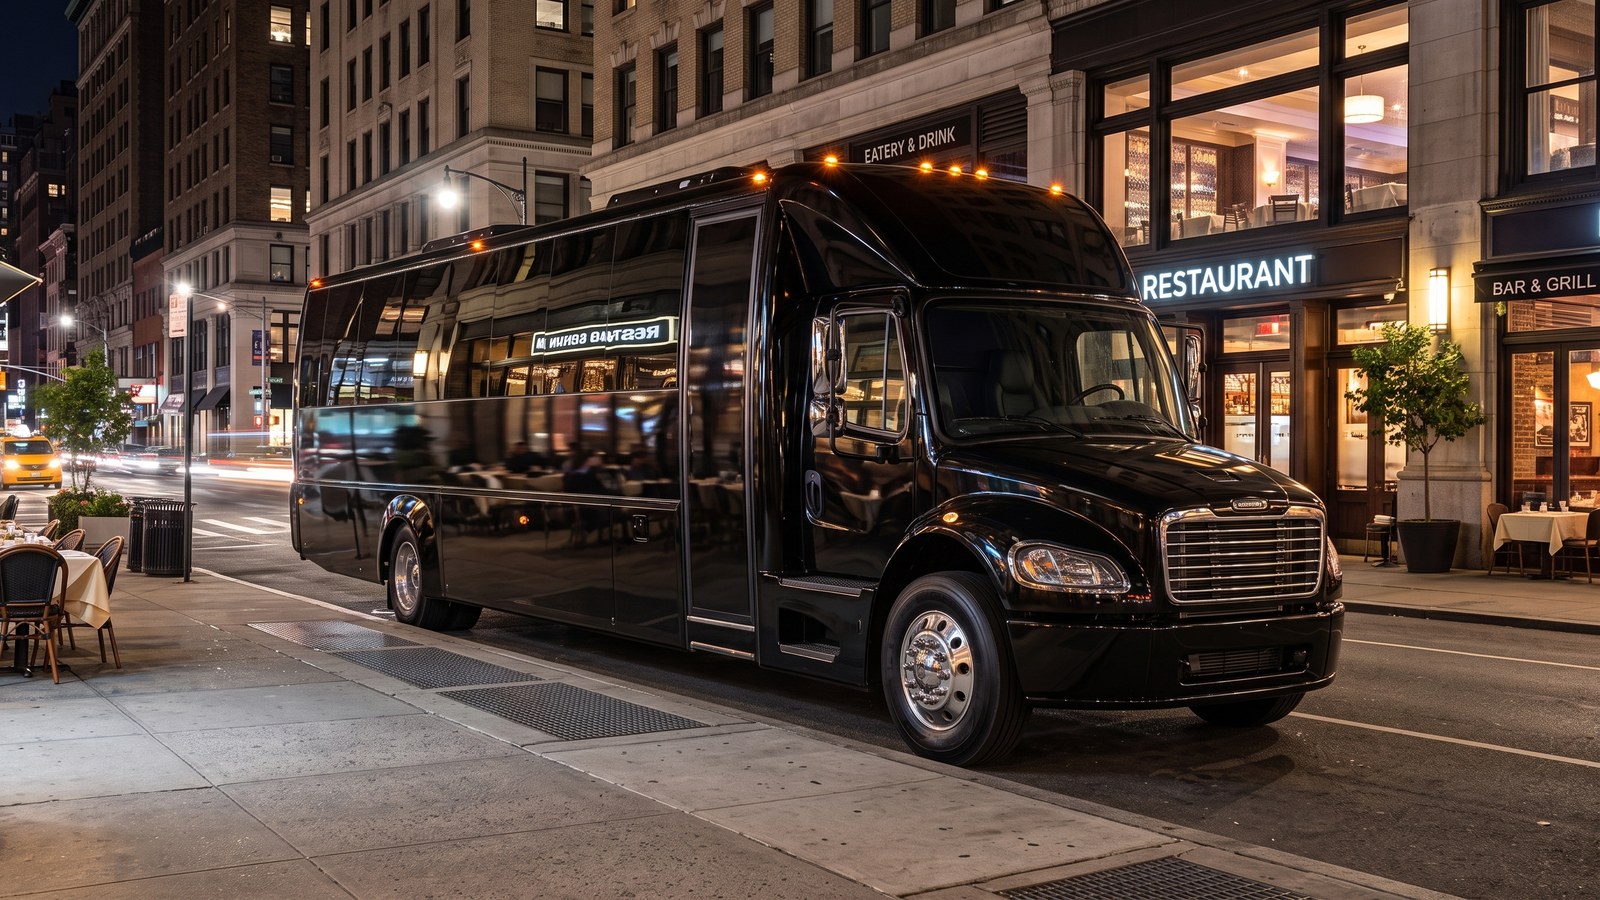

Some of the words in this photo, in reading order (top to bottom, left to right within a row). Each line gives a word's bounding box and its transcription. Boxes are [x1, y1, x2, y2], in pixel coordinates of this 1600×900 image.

[864, 139, 905, 164] EATERY
[907, 137, 916, 153] &
[918, 126, 956, 151] DRINK
[1143, 254, 1314, 300] RESTAURANT
[1493, 280, 1526, 296] BAR
[1530, 278, 1541, 293] &
[1546, 273, 1597, 291] GRILL
